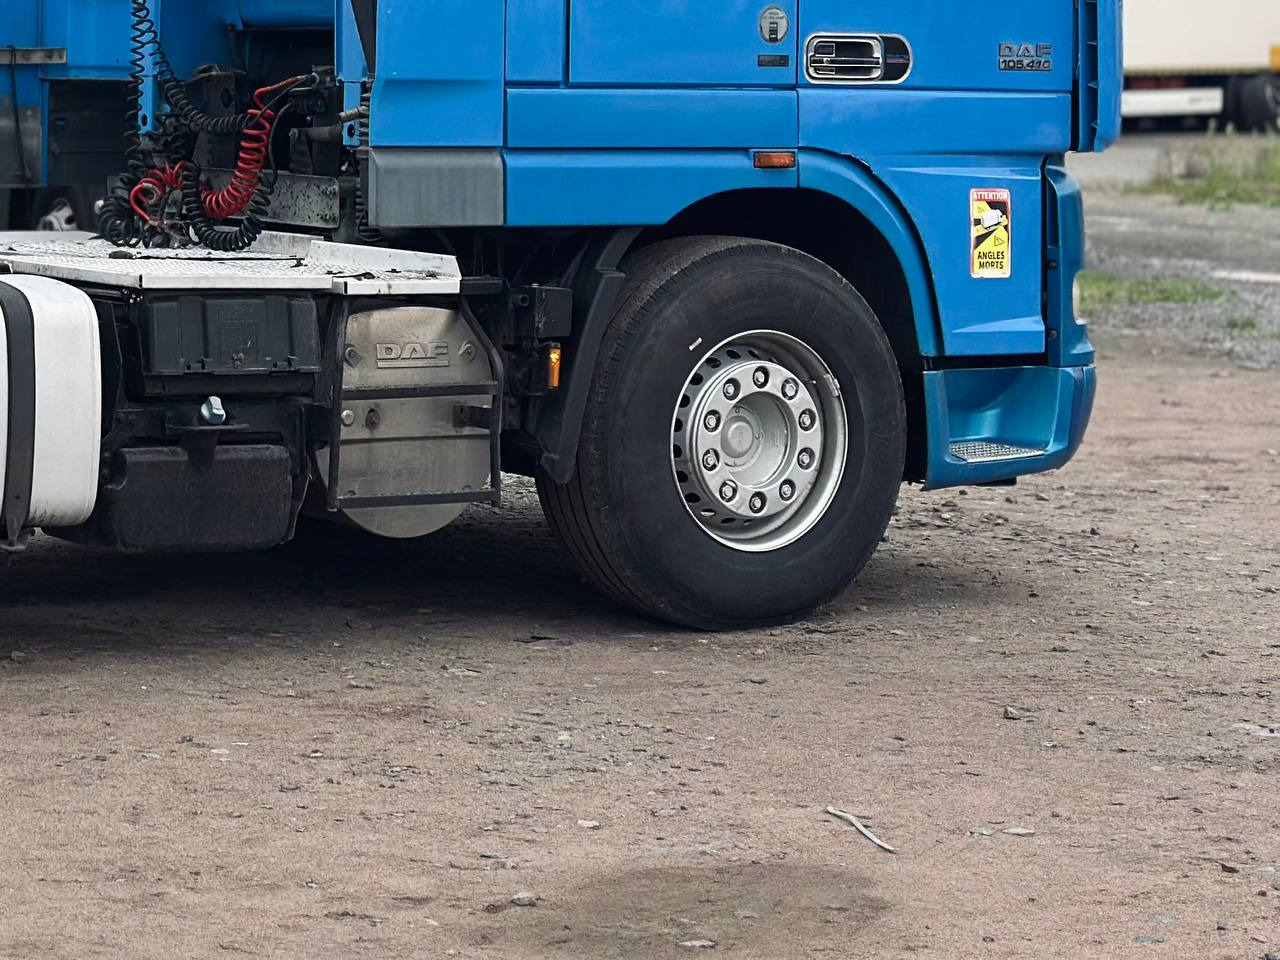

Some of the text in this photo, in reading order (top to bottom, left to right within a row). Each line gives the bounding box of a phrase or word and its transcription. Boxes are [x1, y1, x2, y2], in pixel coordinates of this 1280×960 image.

[999, 43, 1053, 57] DAF
[973, 191, 1008, 199] ATTENTION
[977, 251, 1005, 260] ANGLES
[978, 261, 1004, 270] MORTS
[376, 342, 449, 360] DAF
